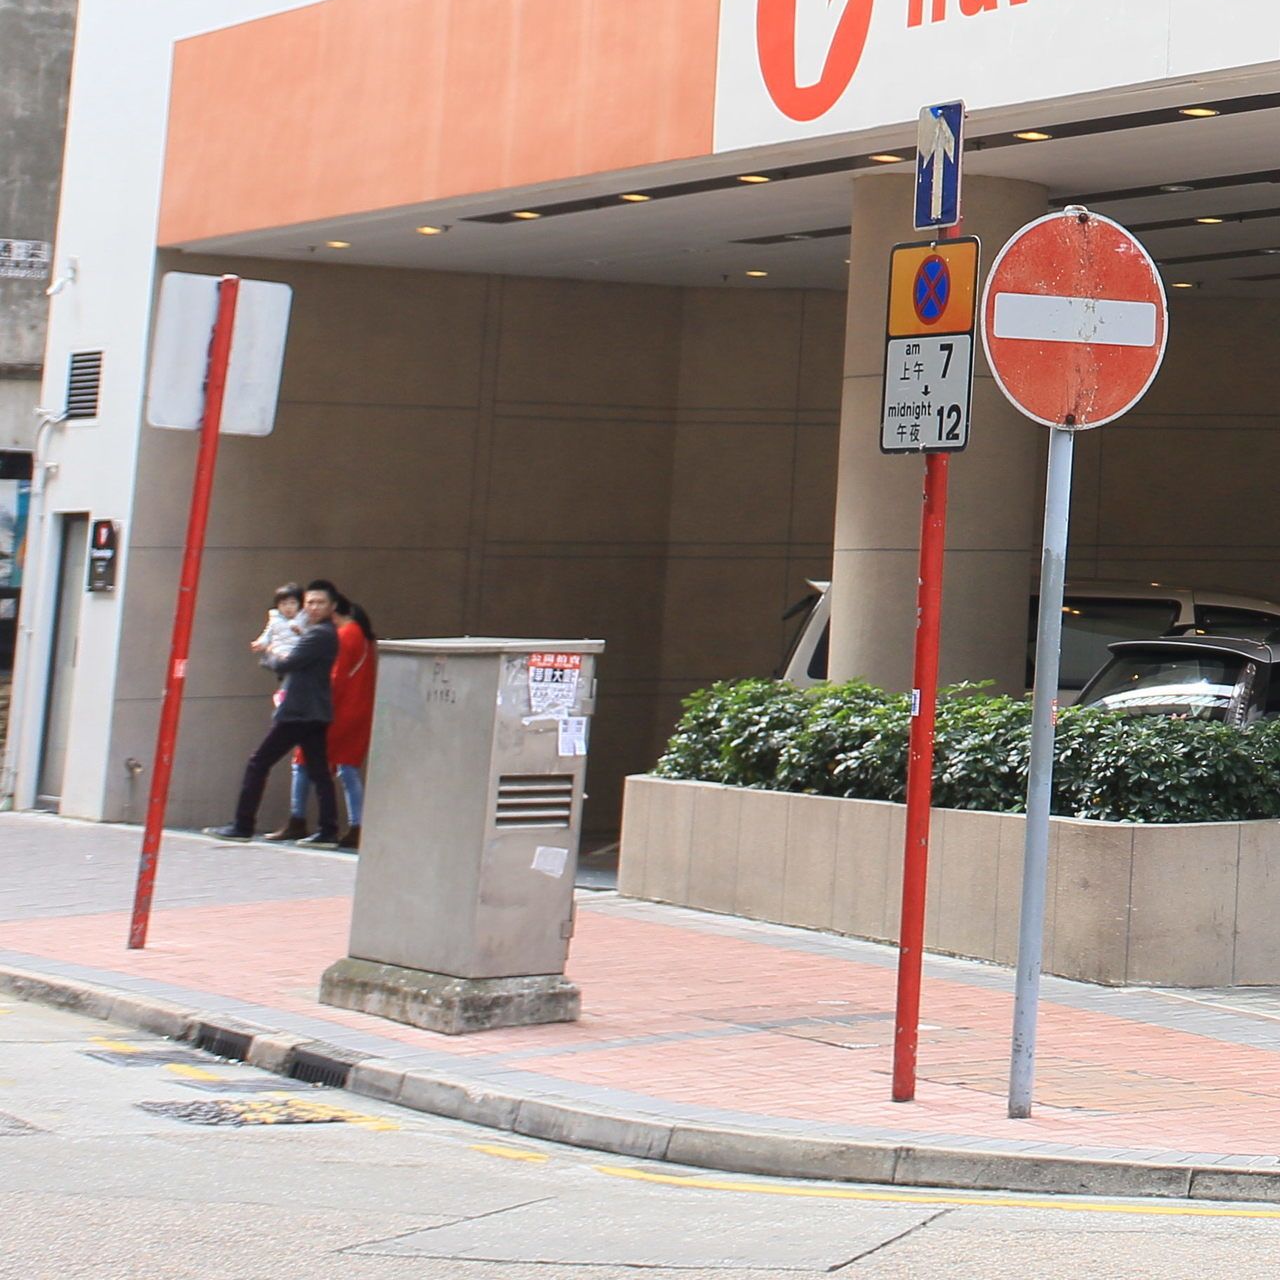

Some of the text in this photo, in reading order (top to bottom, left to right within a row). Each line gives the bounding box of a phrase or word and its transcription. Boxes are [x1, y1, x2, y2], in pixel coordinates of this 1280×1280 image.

[900, 361, 924, 380] 上午
[905, 343, 953, 379] am 7
[888, 401, 962, 441] midnight 12
[896, 423, 920, 442] 午夜
